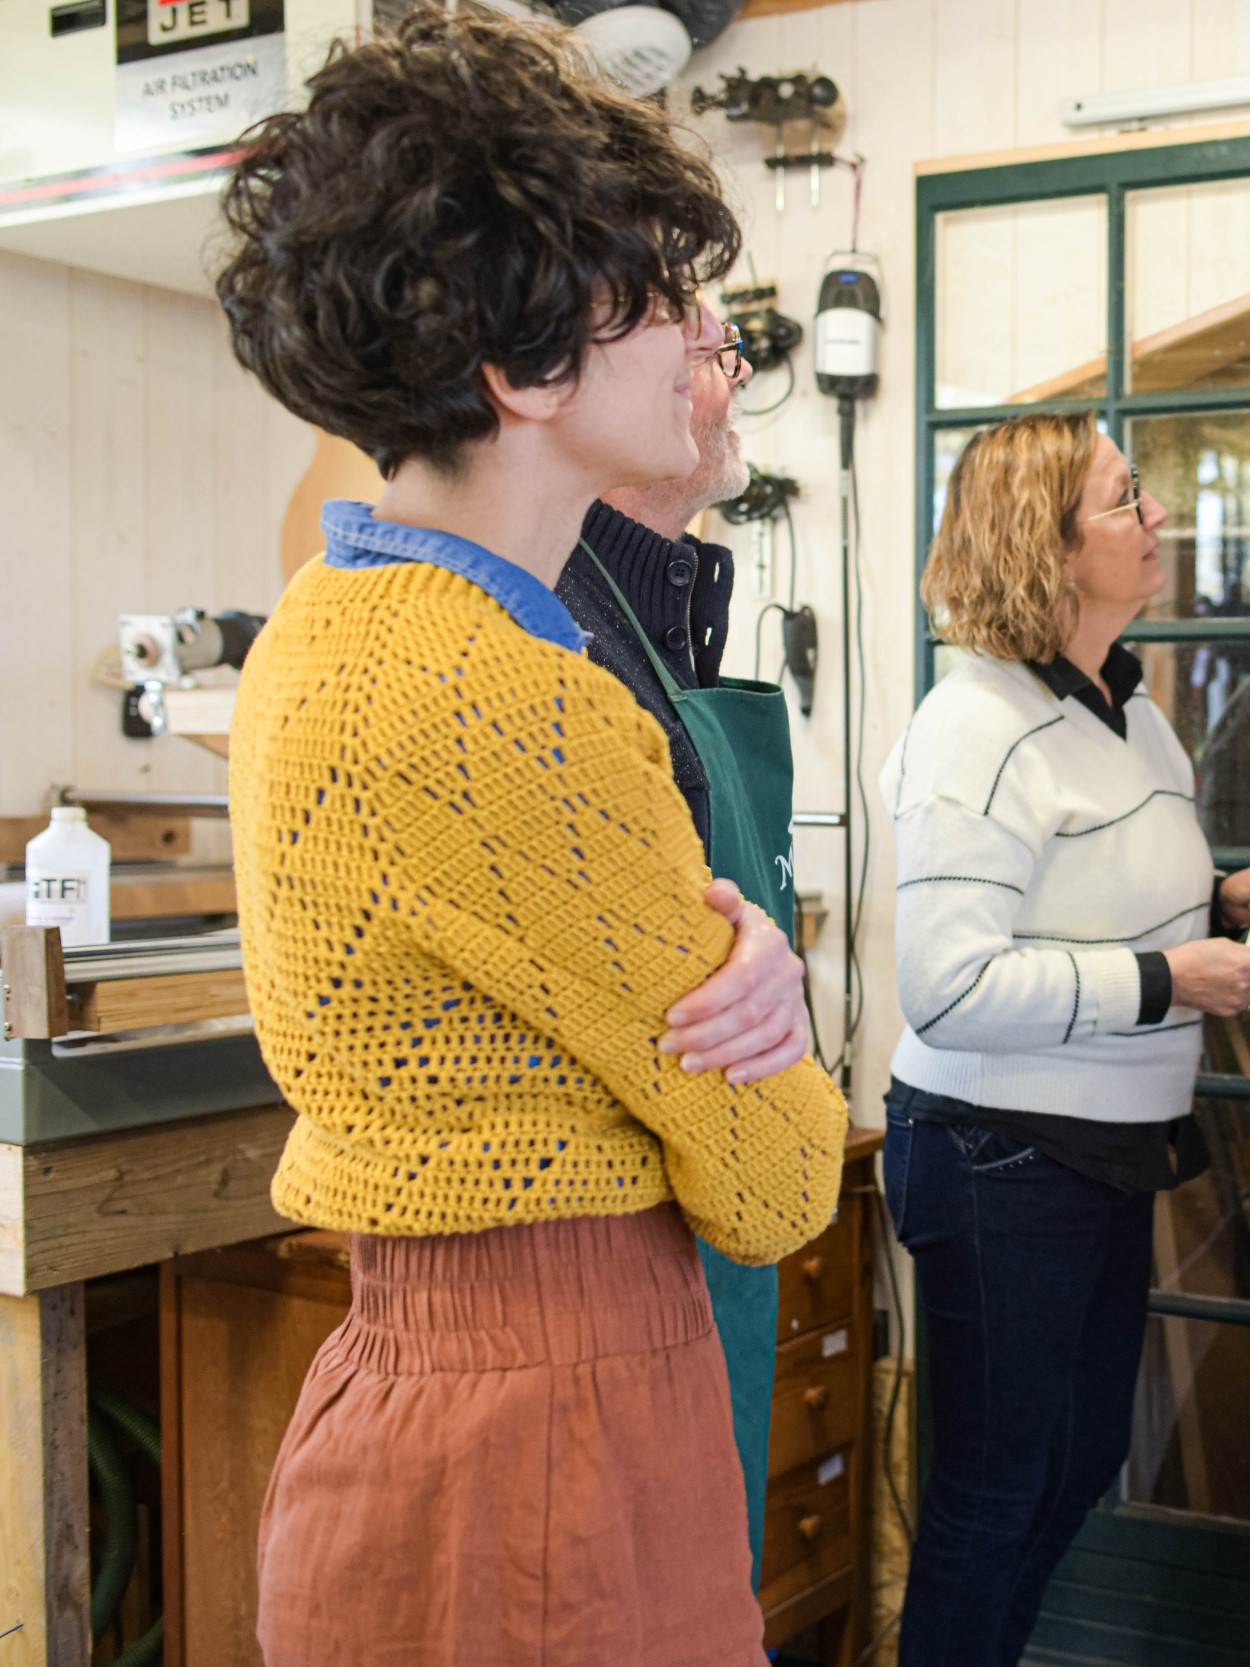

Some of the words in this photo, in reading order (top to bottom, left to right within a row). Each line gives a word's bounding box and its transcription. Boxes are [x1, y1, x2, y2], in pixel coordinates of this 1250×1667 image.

[159, 0, 233, 32] JET
[142, 77, 168, 96] AIR
[170, 61, 258, 91] FILTRATION
[169, 92, 230, 119] SYSTEM
